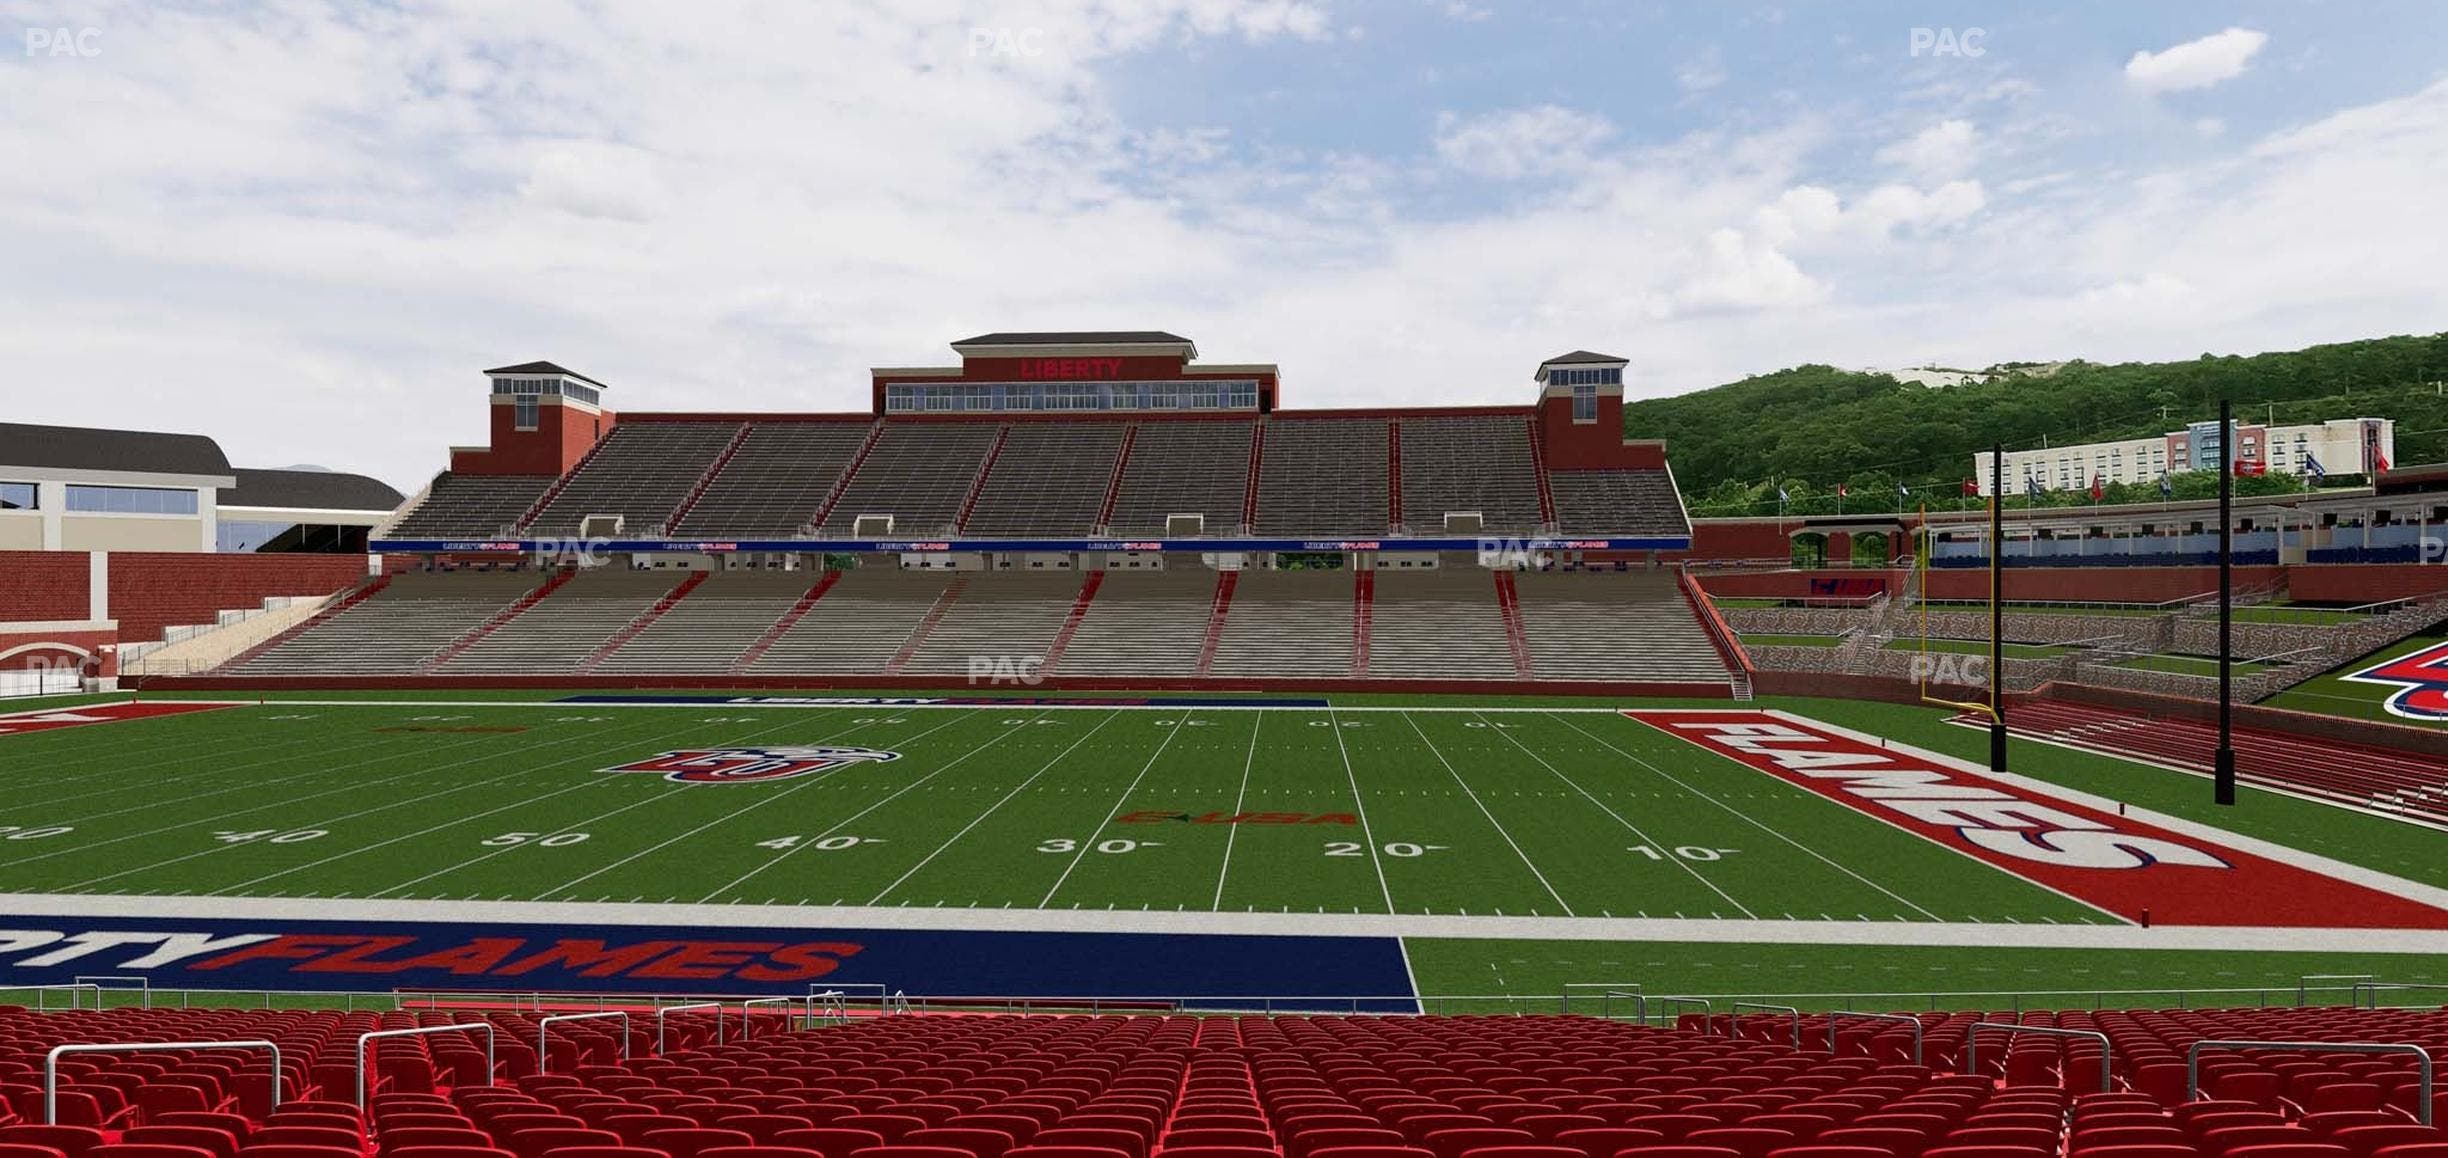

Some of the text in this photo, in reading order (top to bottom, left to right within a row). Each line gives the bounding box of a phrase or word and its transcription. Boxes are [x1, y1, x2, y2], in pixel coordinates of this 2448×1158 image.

[1021, 357, 1122, 379] LIBERTY
[1670, 722, 2237, 869] FLAMES
[481, 832, 590, 847] 50
[755, 835, 858, 850] 40
[1037, 839, 1136, 854] 30
[1324, 842, 1424, 857] 20
[1627, 845, 1720, 860] 10
